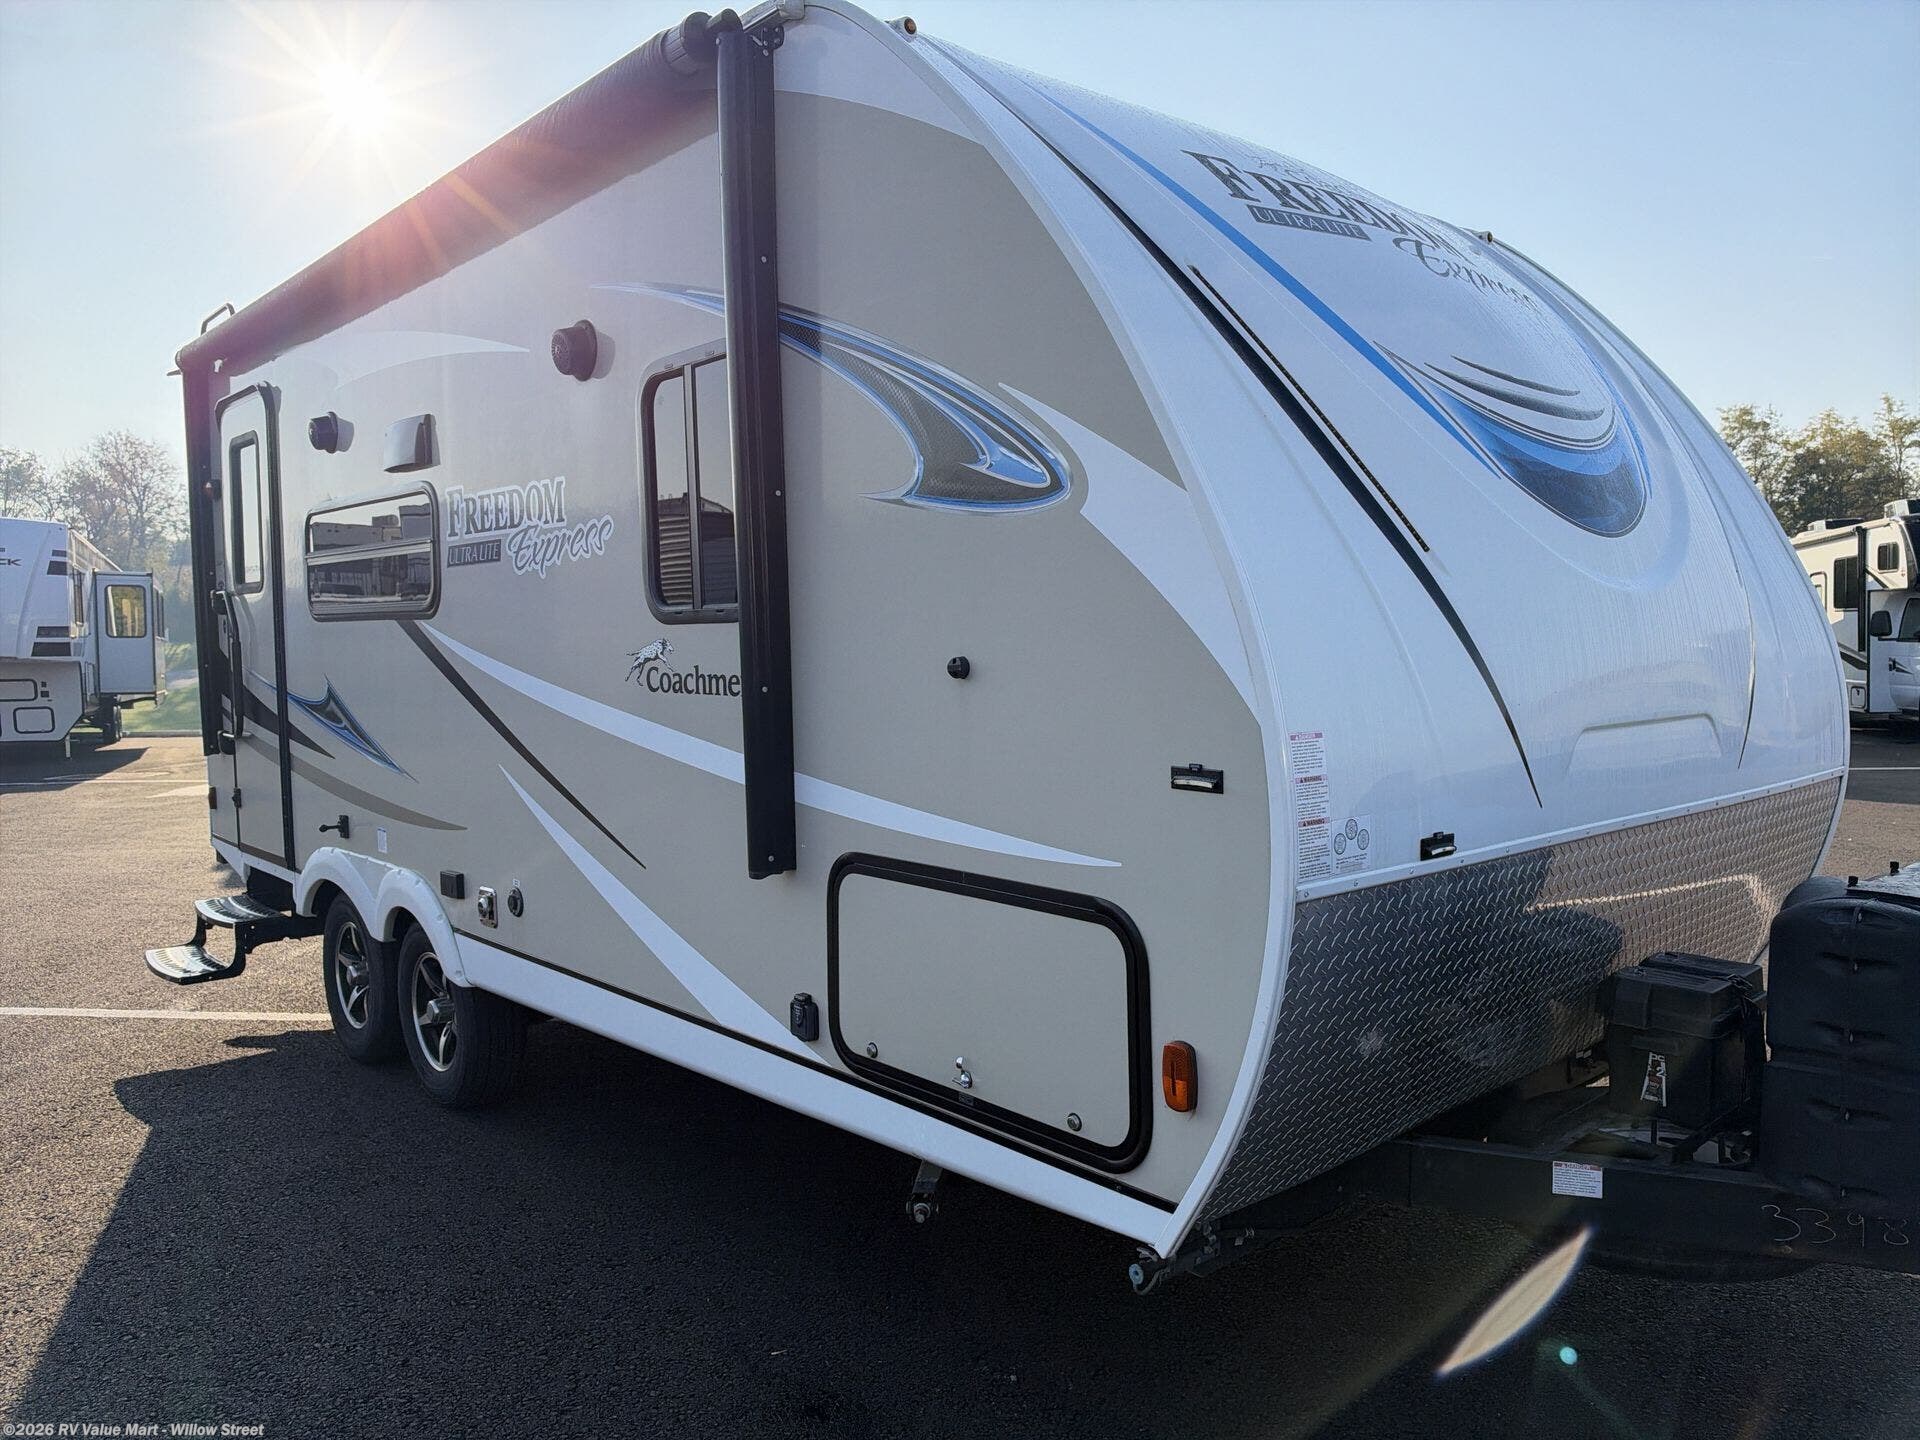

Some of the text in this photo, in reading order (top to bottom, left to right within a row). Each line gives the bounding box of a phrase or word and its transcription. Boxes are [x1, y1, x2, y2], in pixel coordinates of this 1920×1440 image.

[1251, 206, 1367, 238] ULTRALITE
[446, 479, 566, 538] FREEDOM
[449, 542, 500, 566] ULTRALITE
[508, 517, 614, 575] Express
[646, 665, 742, 697] Coachme
